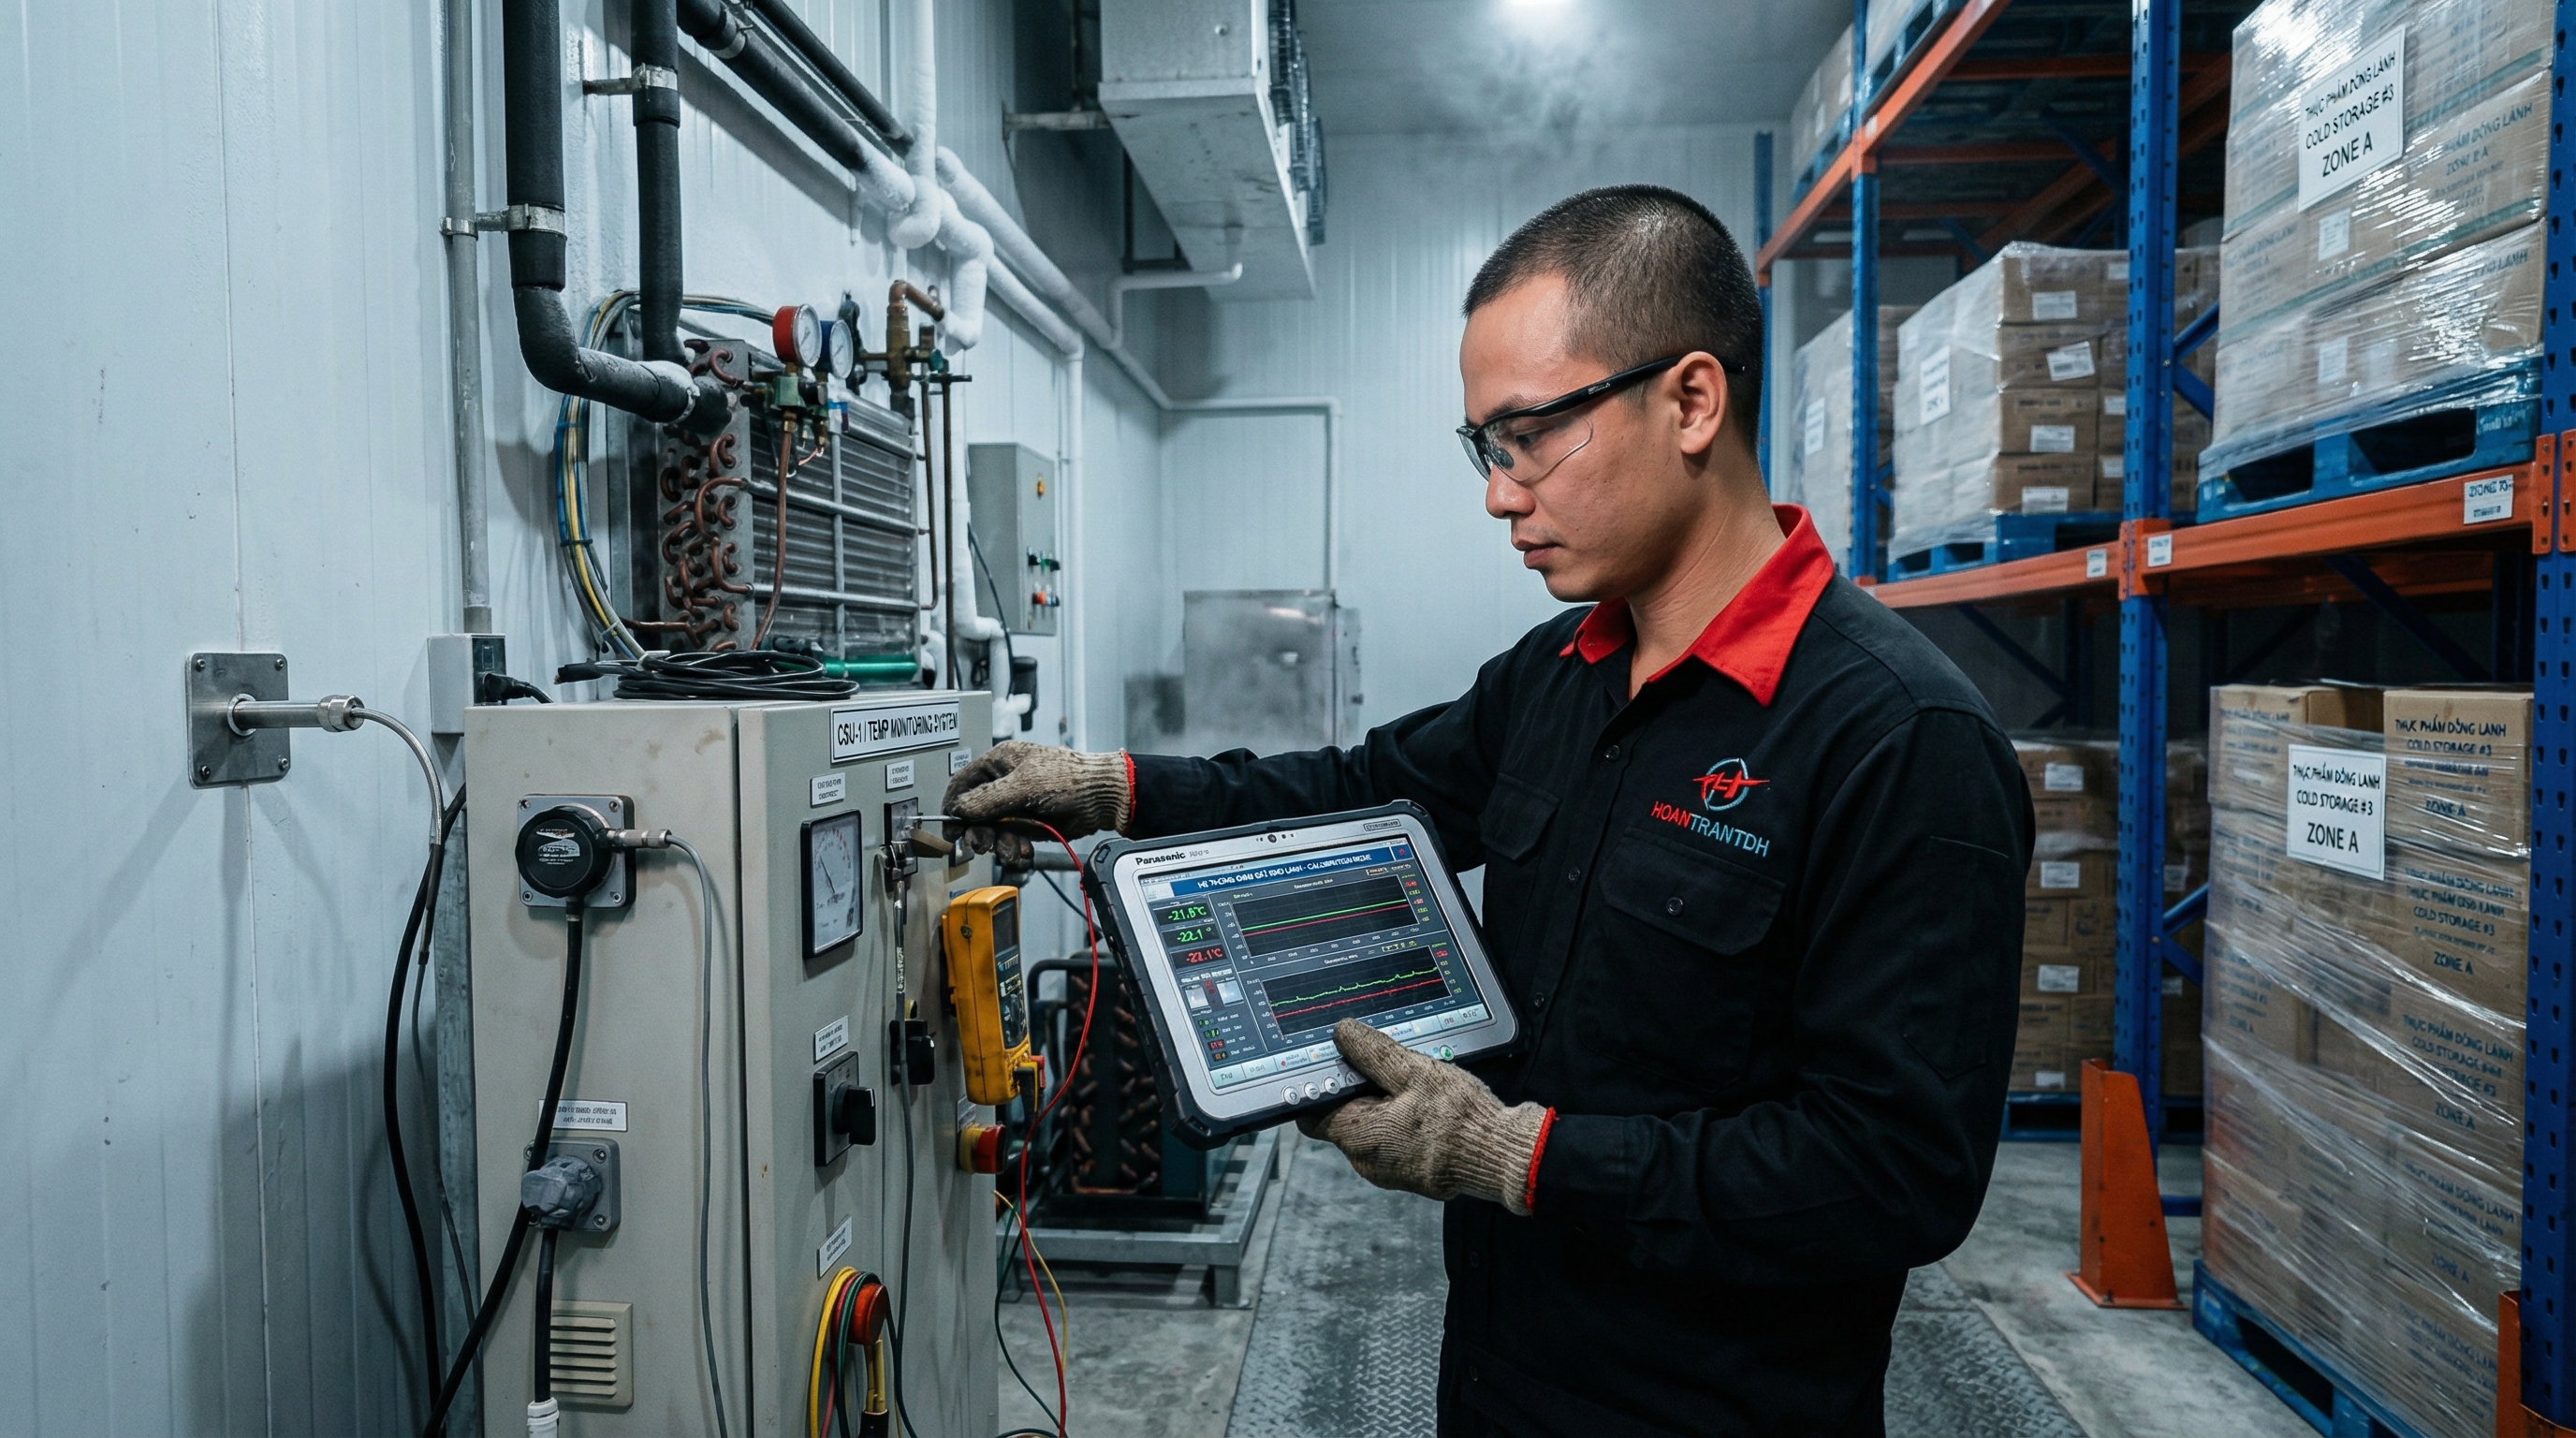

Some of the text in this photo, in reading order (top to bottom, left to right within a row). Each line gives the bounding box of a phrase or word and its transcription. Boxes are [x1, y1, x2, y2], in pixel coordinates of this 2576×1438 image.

[2305, 123, 2331, 150] COLD
[2333, 91, 2379, 134] STORAGE
[2322, 131, 2373, 177] ZONE A
[838, 722, 861, 745] CSU-1
[2297, 790, 2318, 806] COLD
[2320, 793, 2359, 814] STORAGE
[1651, 800, 1769, 858] HOANTRANTDH
[2307, 822, 2359, 853] ZONE A
